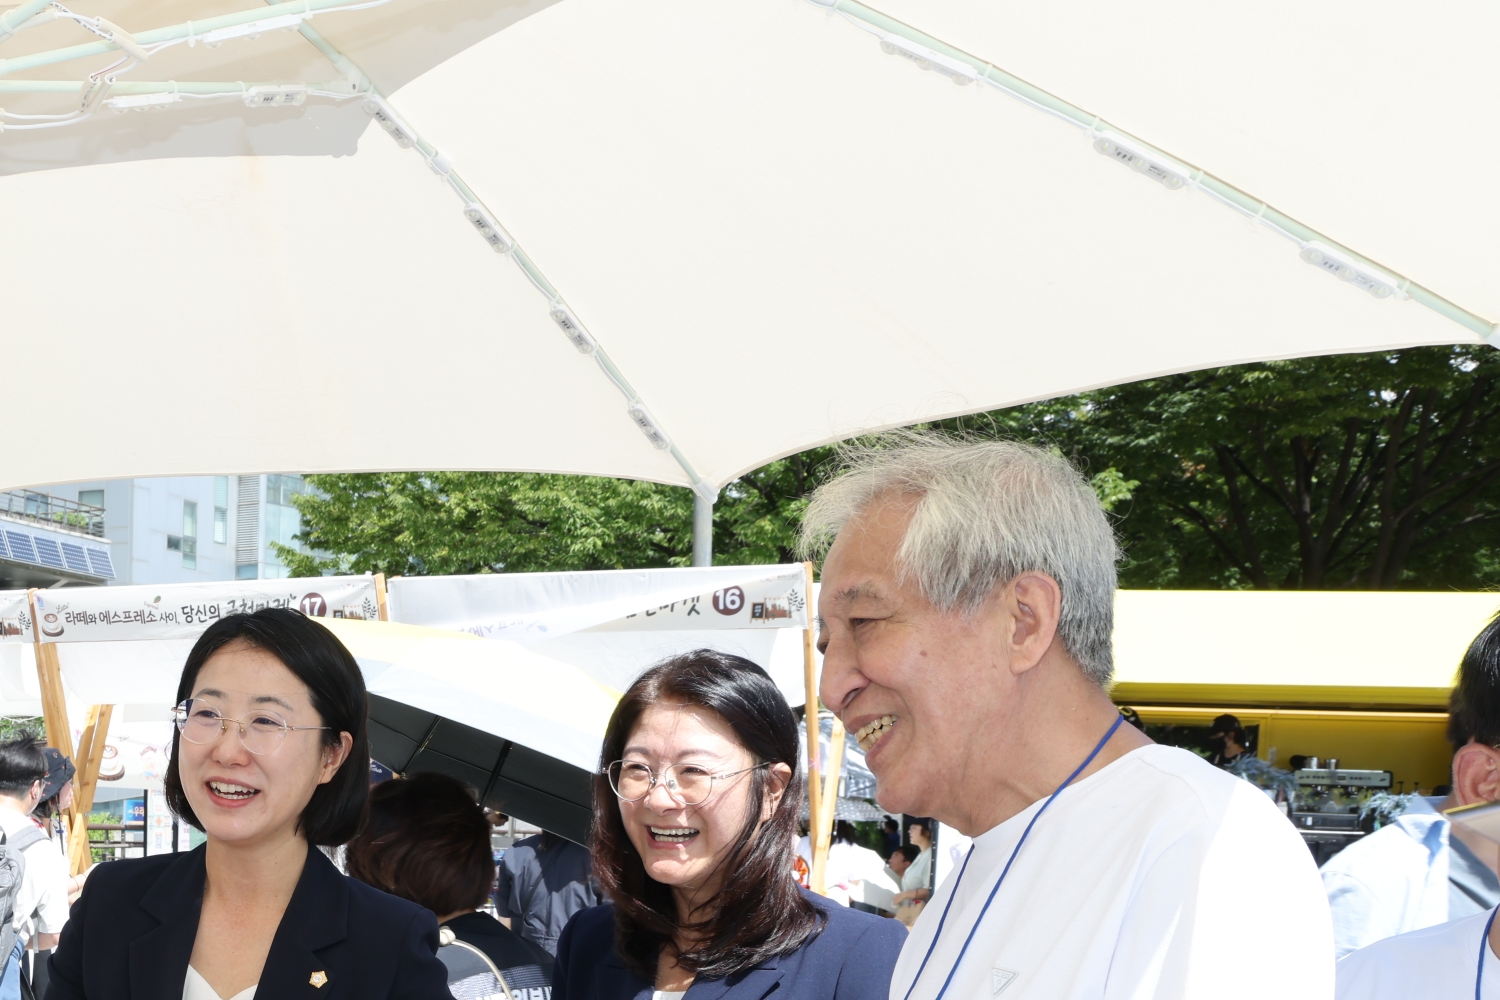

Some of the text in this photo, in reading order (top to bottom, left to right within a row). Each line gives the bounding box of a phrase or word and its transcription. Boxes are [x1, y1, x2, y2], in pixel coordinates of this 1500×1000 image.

[64, 608, 97, 627] 라떼와
[99, 605, 158, 625] 에스프레소
[159, 609, 181, 625] 사이,
[181, 602, 221, 622] 당신의
[301, 597, 322, 617] 17
[714, 588, 741, 610] 16
